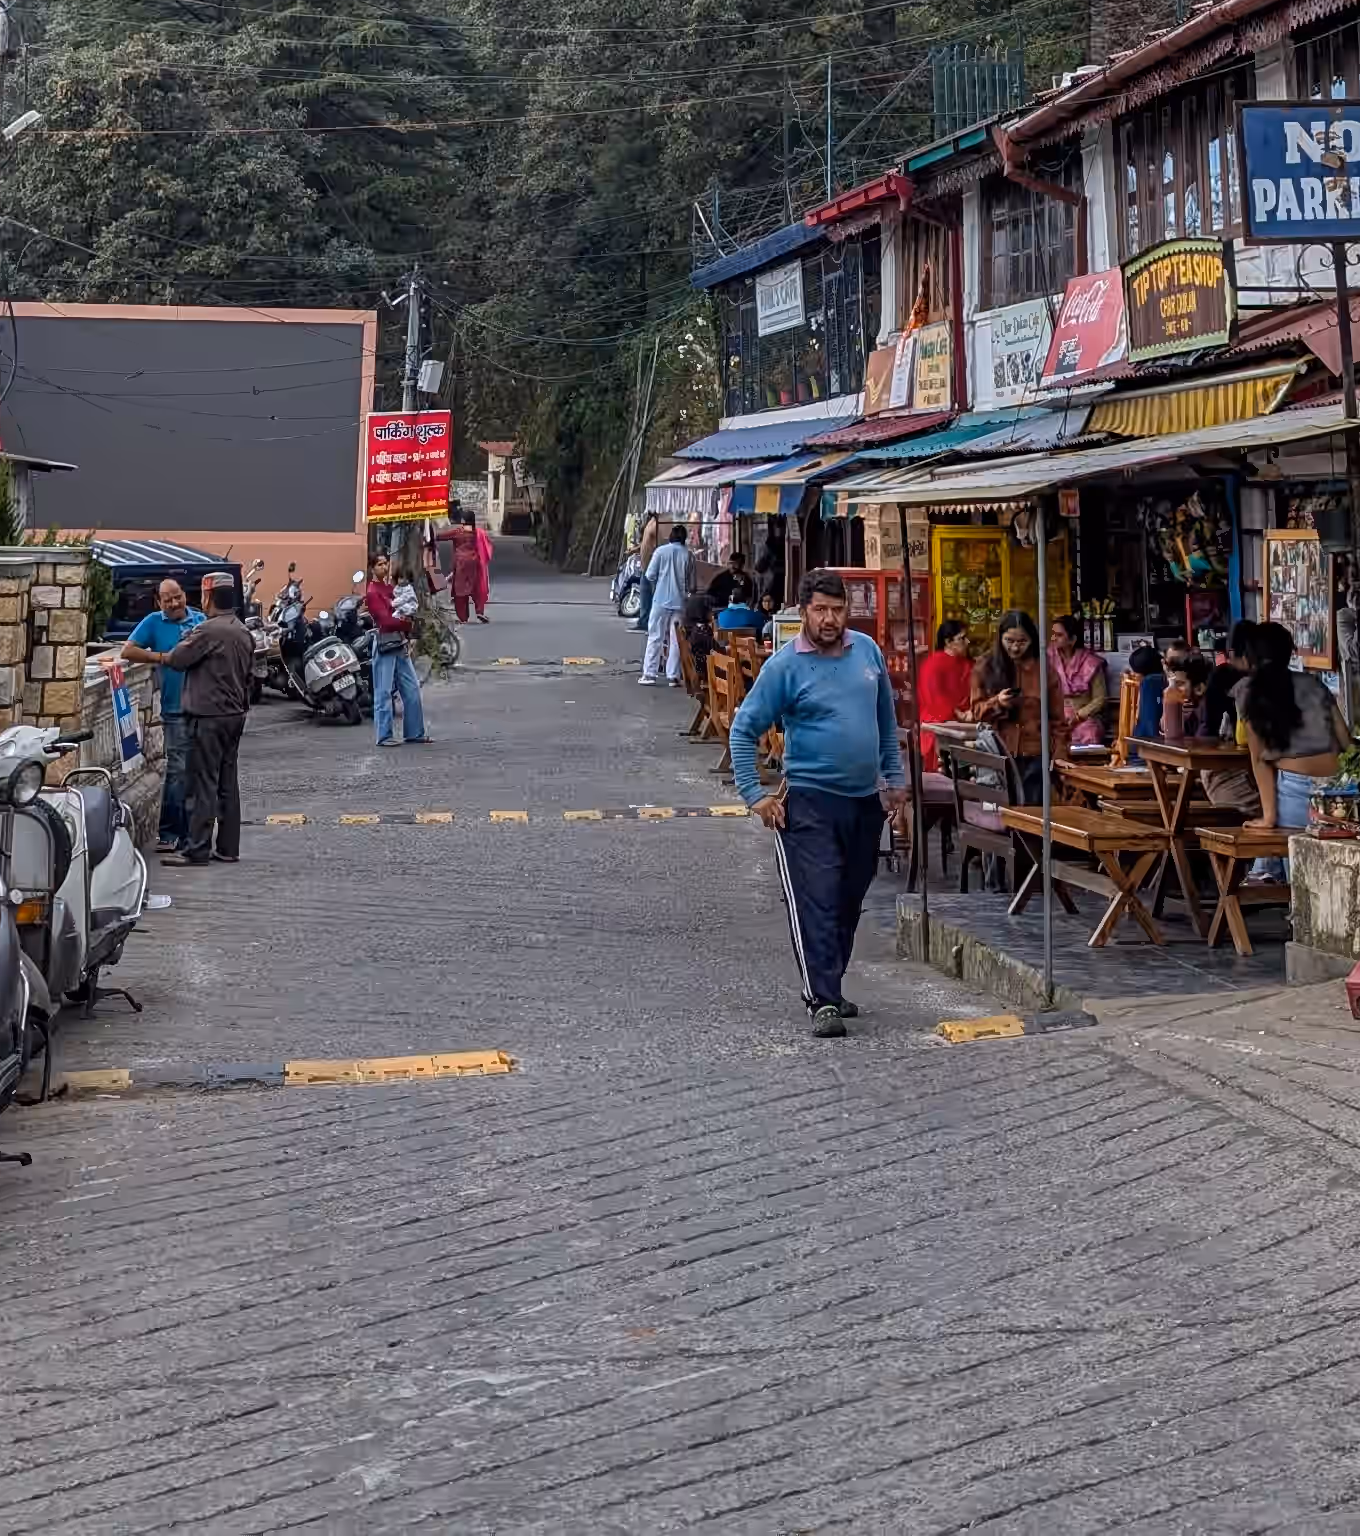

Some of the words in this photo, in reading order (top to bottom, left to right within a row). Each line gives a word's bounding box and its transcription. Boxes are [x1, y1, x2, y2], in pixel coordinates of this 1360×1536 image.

[1133, 270, 1150, 309] TIP
[1150, 258, 1172, 293] TOP
[374, 421, 414, 441] पार्किंग
[415, 423, 446, 444] शुल्क
